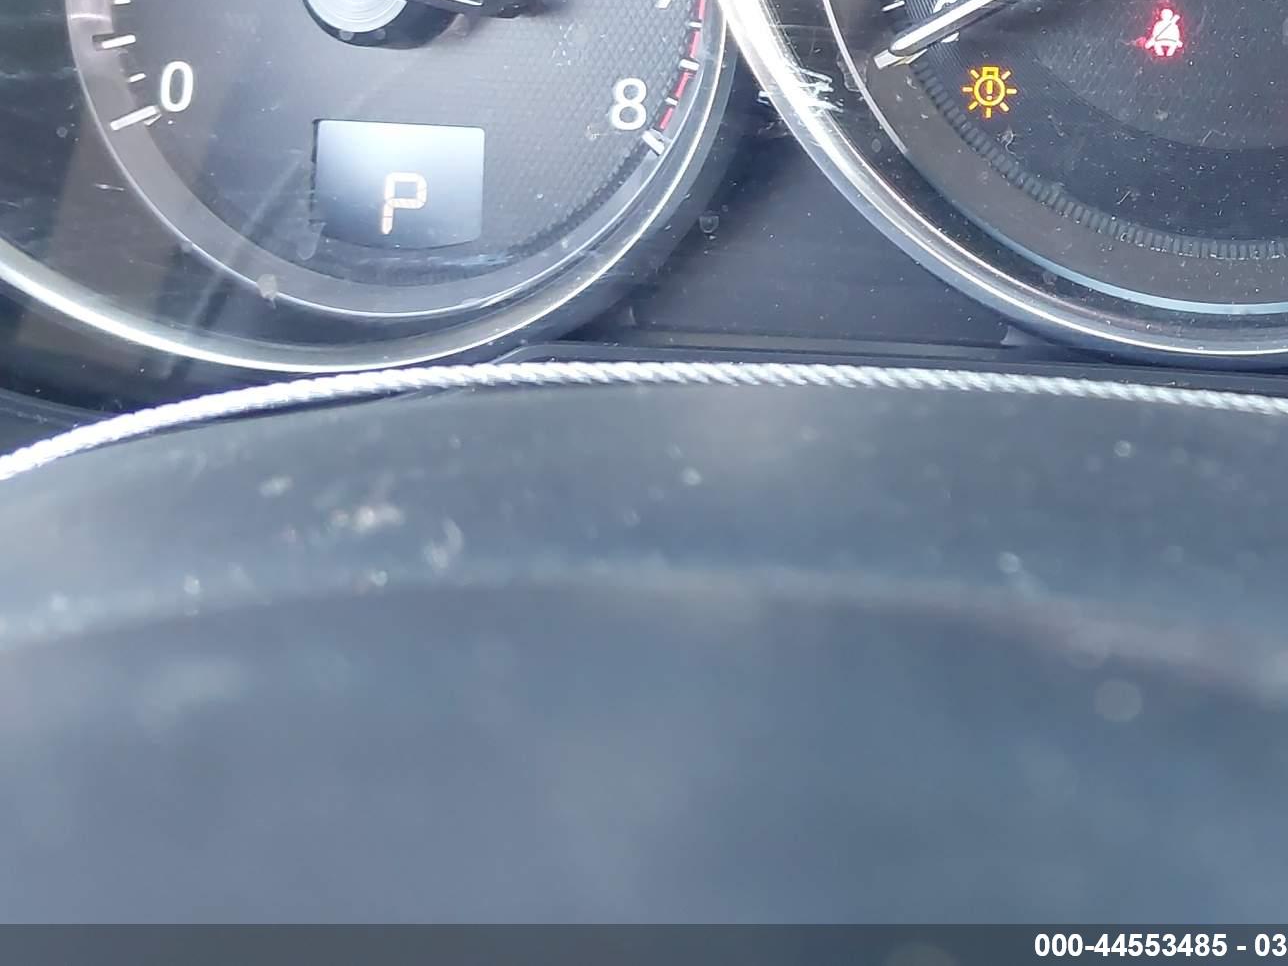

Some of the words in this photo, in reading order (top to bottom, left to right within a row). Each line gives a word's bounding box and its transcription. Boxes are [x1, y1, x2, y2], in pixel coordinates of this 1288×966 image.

[160, 60, 194, 112] 0
[609, 77, 647, 131] 8
[381, 171, 428, 235] P
